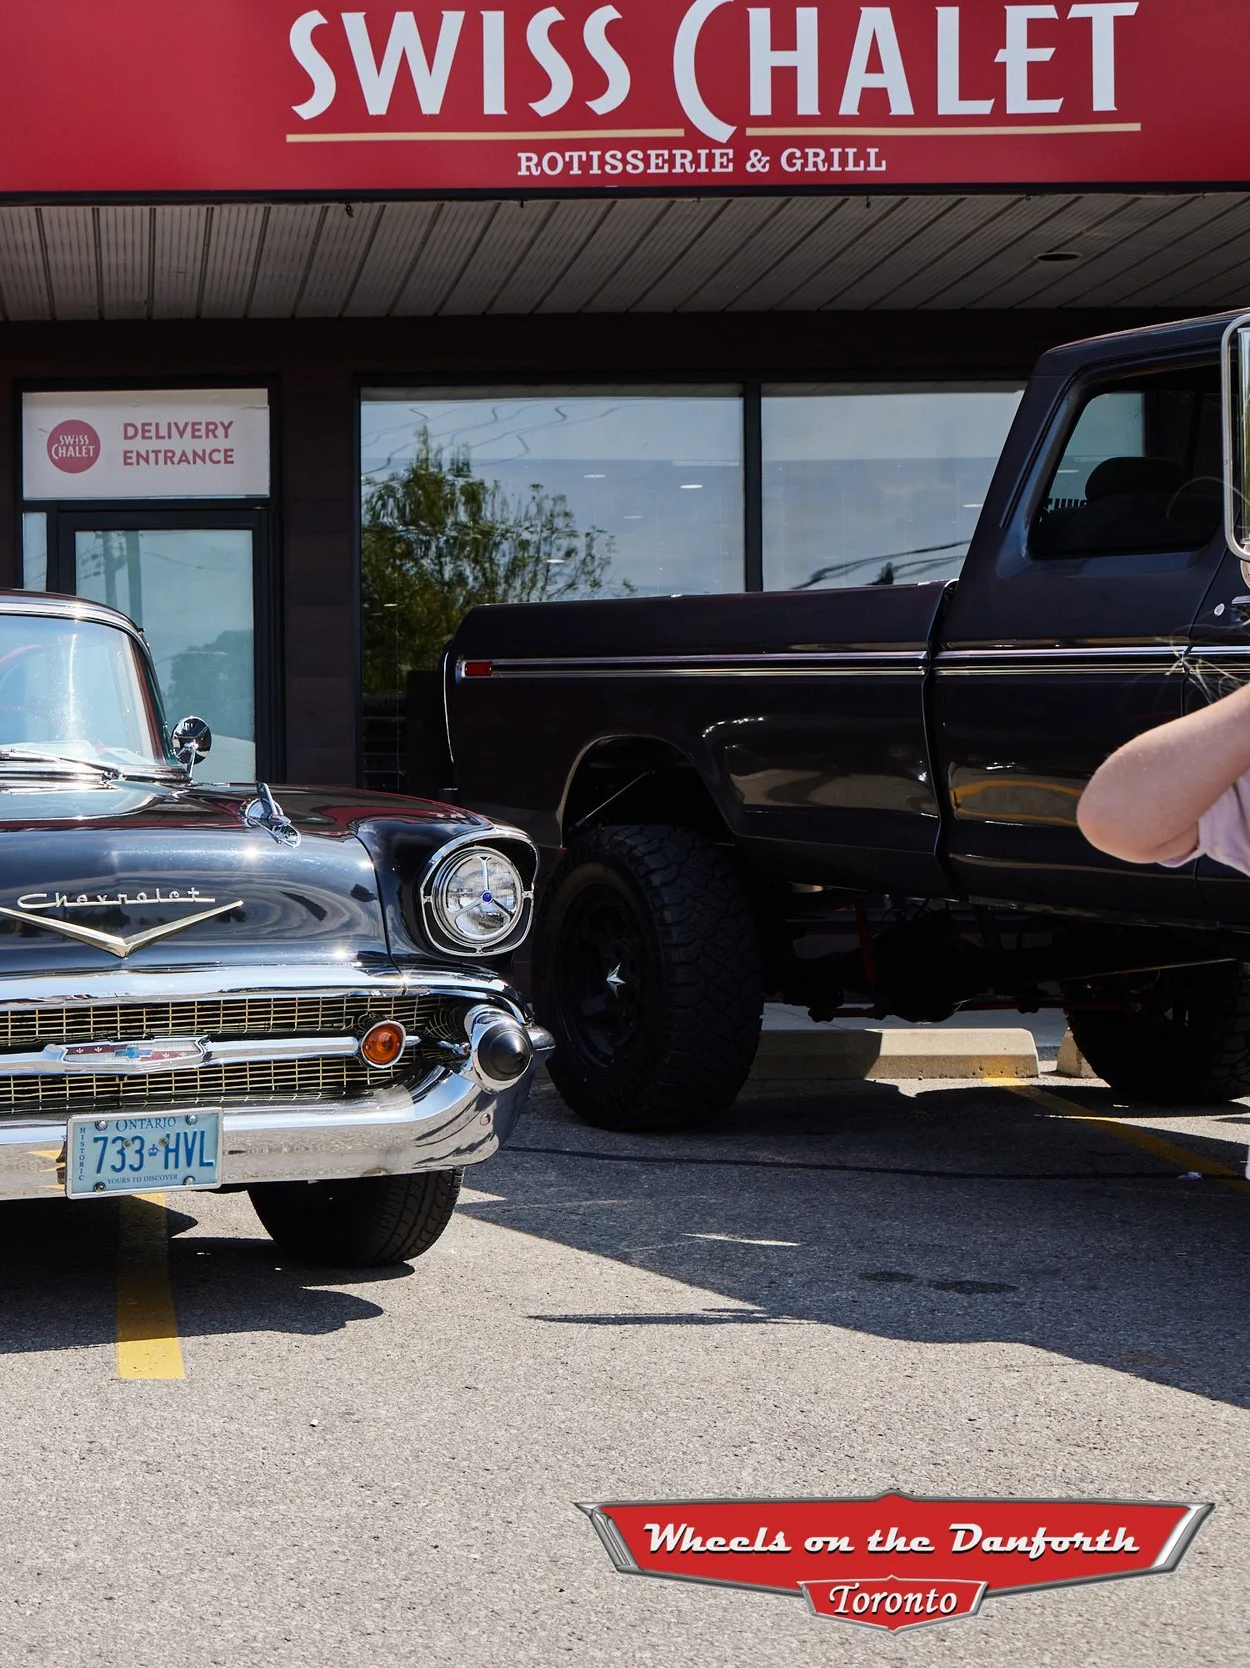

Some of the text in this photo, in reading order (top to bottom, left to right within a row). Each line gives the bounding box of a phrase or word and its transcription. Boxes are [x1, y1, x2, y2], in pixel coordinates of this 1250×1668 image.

[288, 0, 1140, 144] SWISS CHALET
[517, 148, 886, 176] ROTISSERIE & GRILL
[59, 434, 89, 445] SWISS
[123, 421, 233, 440] DELIVERY
[51, 443, 95, 460] CHALET
[123, 448, 234, 466] ENTRANCE
[17, 887, 216, 908] Chevrolet
[115, 1116, 177, 1132] ONTARIO
[78, 1127, 87, 1181] HISTORIC
[93, 1130, 215, 1175] 733 HVL
[107, 1173, 178, 1185] YOURS TO DISCOVER
